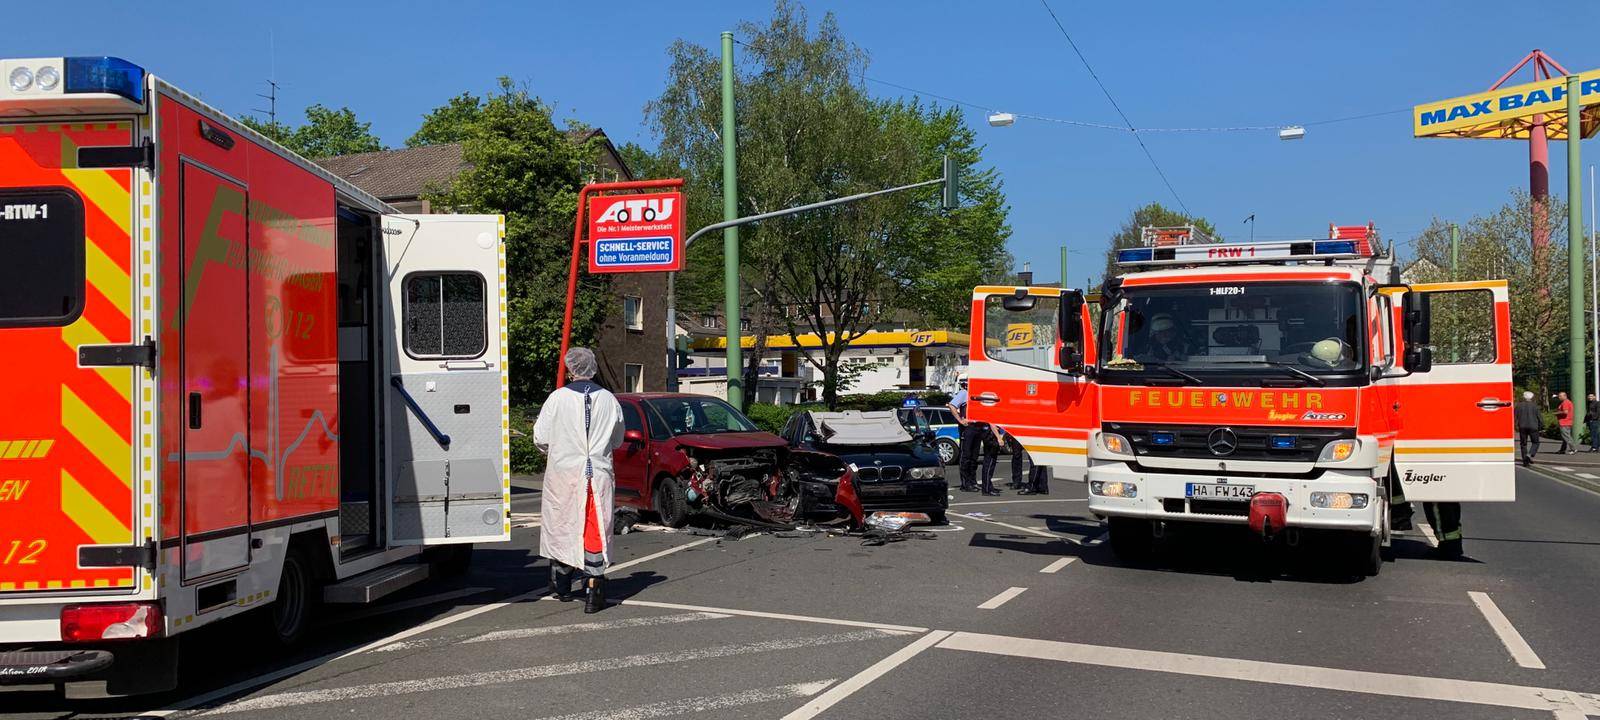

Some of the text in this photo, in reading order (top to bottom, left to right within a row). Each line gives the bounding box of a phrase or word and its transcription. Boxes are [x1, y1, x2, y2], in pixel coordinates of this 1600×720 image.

[1421, 100, 1493, 126] MAX
[600, 241, 670, 252] SCHNELL-SERVICE
[599, 252, 669, 263] ohne Voranmeldung
[1208, 247, 1254, 258] FRW 1
[1209, 287, 1245, 295] 1-HLF20-1
[286, 310, 315, 338] 112
[914, 335, 932, 343] JET
[1009, 332, 1030, 341] JET
[1129, 391, 1323, 409] FEUERWEHR
[1403, 470, 1446, 485] Ziegler
[1193, 485, 1253, 498] HA FW 143
